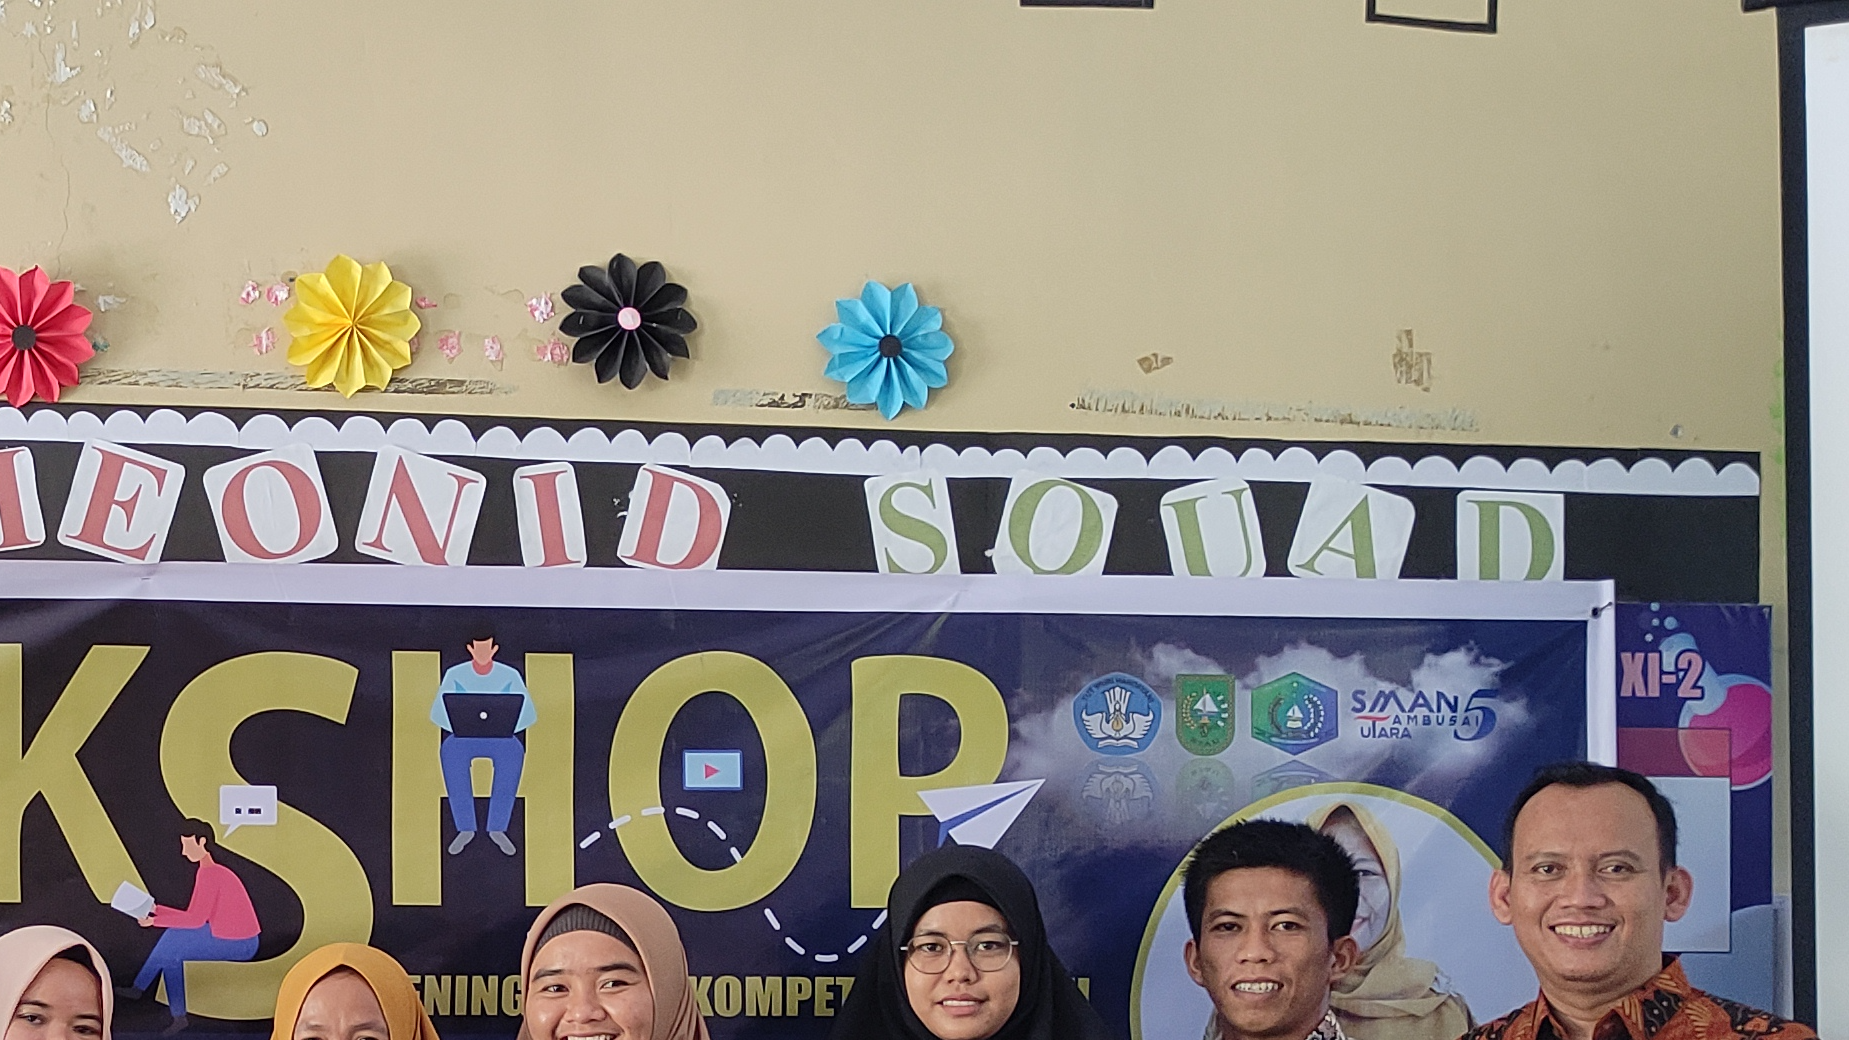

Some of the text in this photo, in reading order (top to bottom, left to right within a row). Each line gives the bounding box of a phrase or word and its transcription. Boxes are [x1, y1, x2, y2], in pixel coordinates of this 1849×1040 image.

[1621, 652, 1704, 698] XI-2
[1351, 689, 1499, 741] SMAN 5
